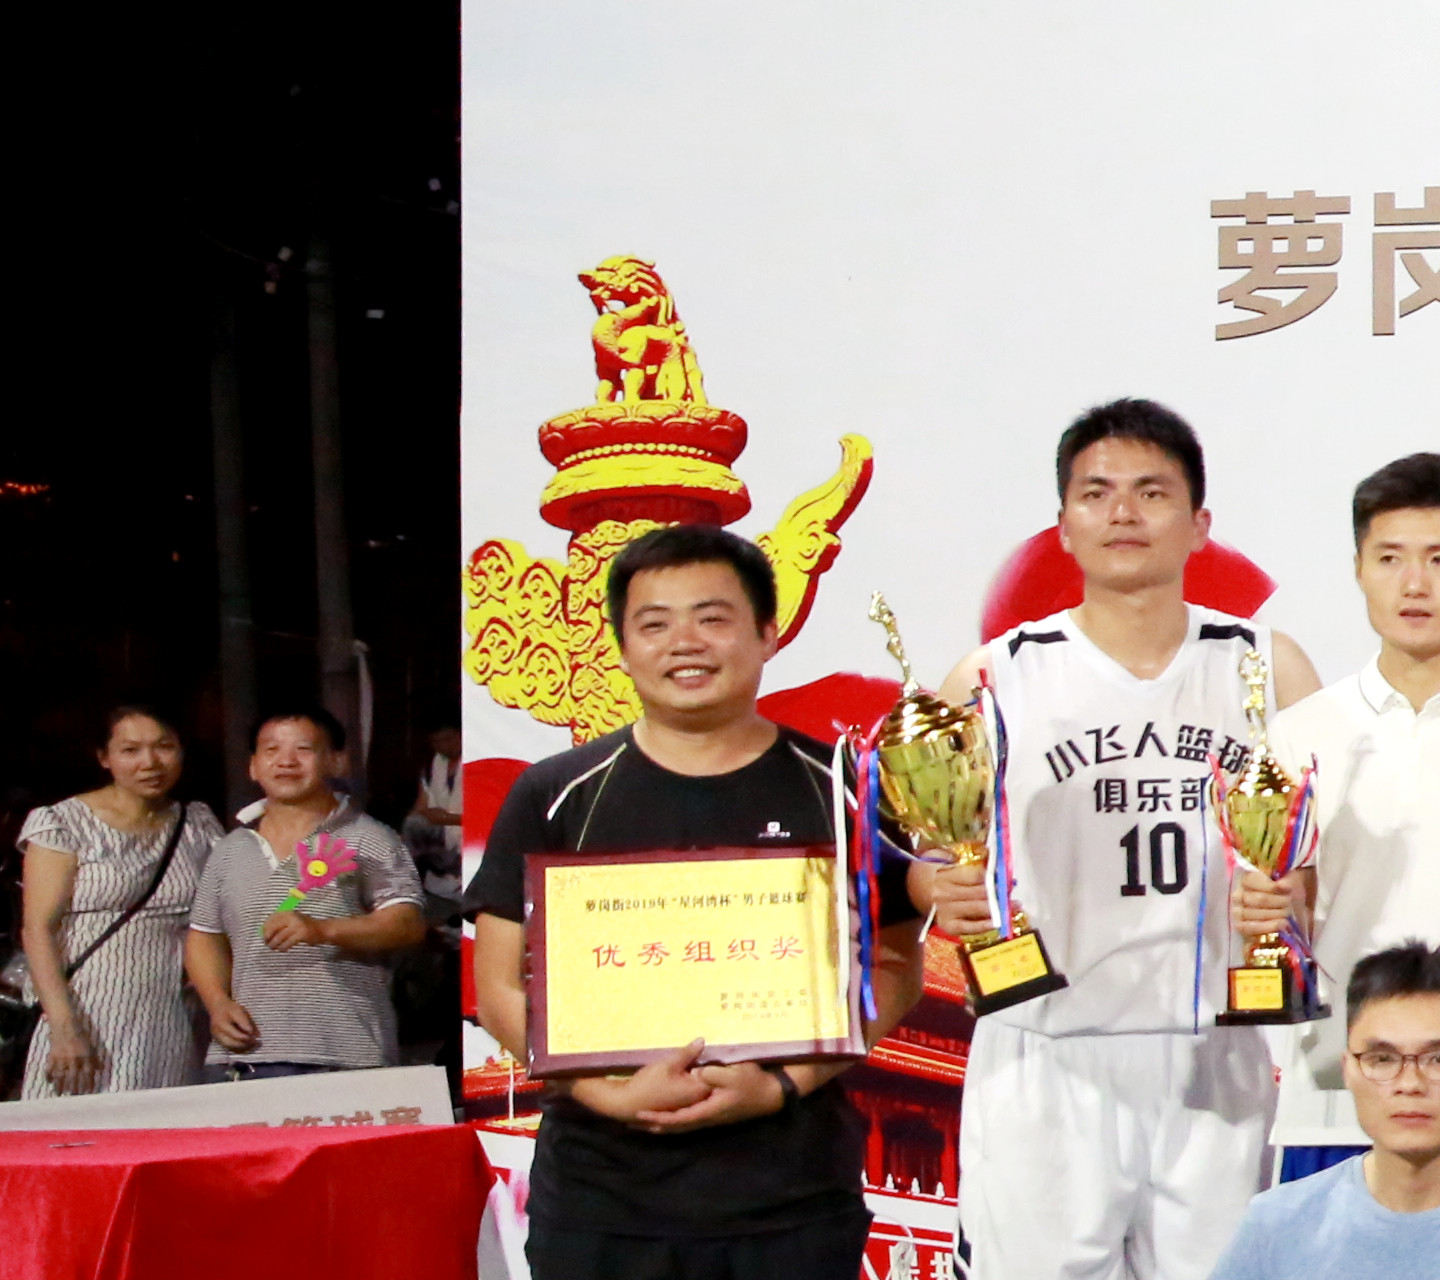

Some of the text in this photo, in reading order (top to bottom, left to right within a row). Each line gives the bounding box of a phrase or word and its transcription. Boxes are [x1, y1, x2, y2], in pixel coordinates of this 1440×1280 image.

[1120, 821, 1189, 897] 10
[592, 936, 804, 969] 优秀组织奖
